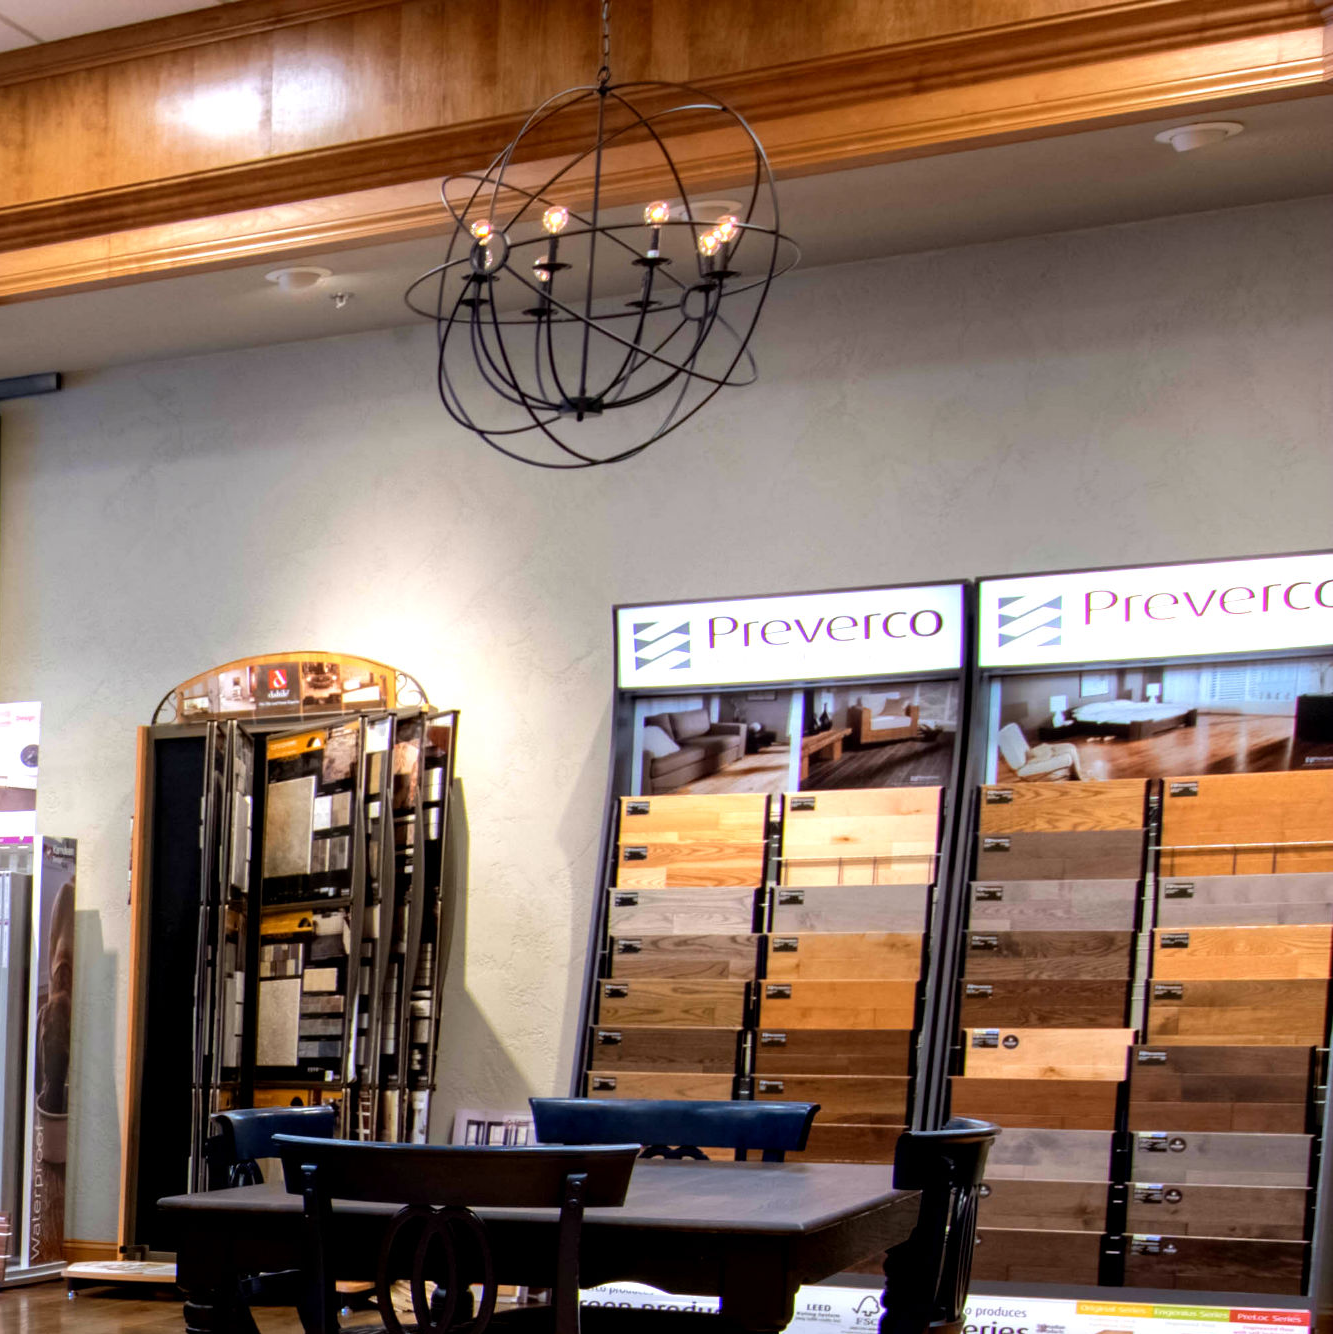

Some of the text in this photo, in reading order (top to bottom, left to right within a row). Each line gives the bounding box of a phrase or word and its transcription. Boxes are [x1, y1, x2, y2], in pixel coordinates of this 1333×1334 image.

[708, 609, 944, 649] Preverco
[29, 1112, 44, 1260] Waterproof
[806, 1303, 832, 1312] LEED
[975, 1306, 1027, 1318] produces
[1080, 1303, 1147, 1314] Original Series
[1199, 1310, 1229, 1319] Series
[1272, 1314, 1302, 1323] Series
